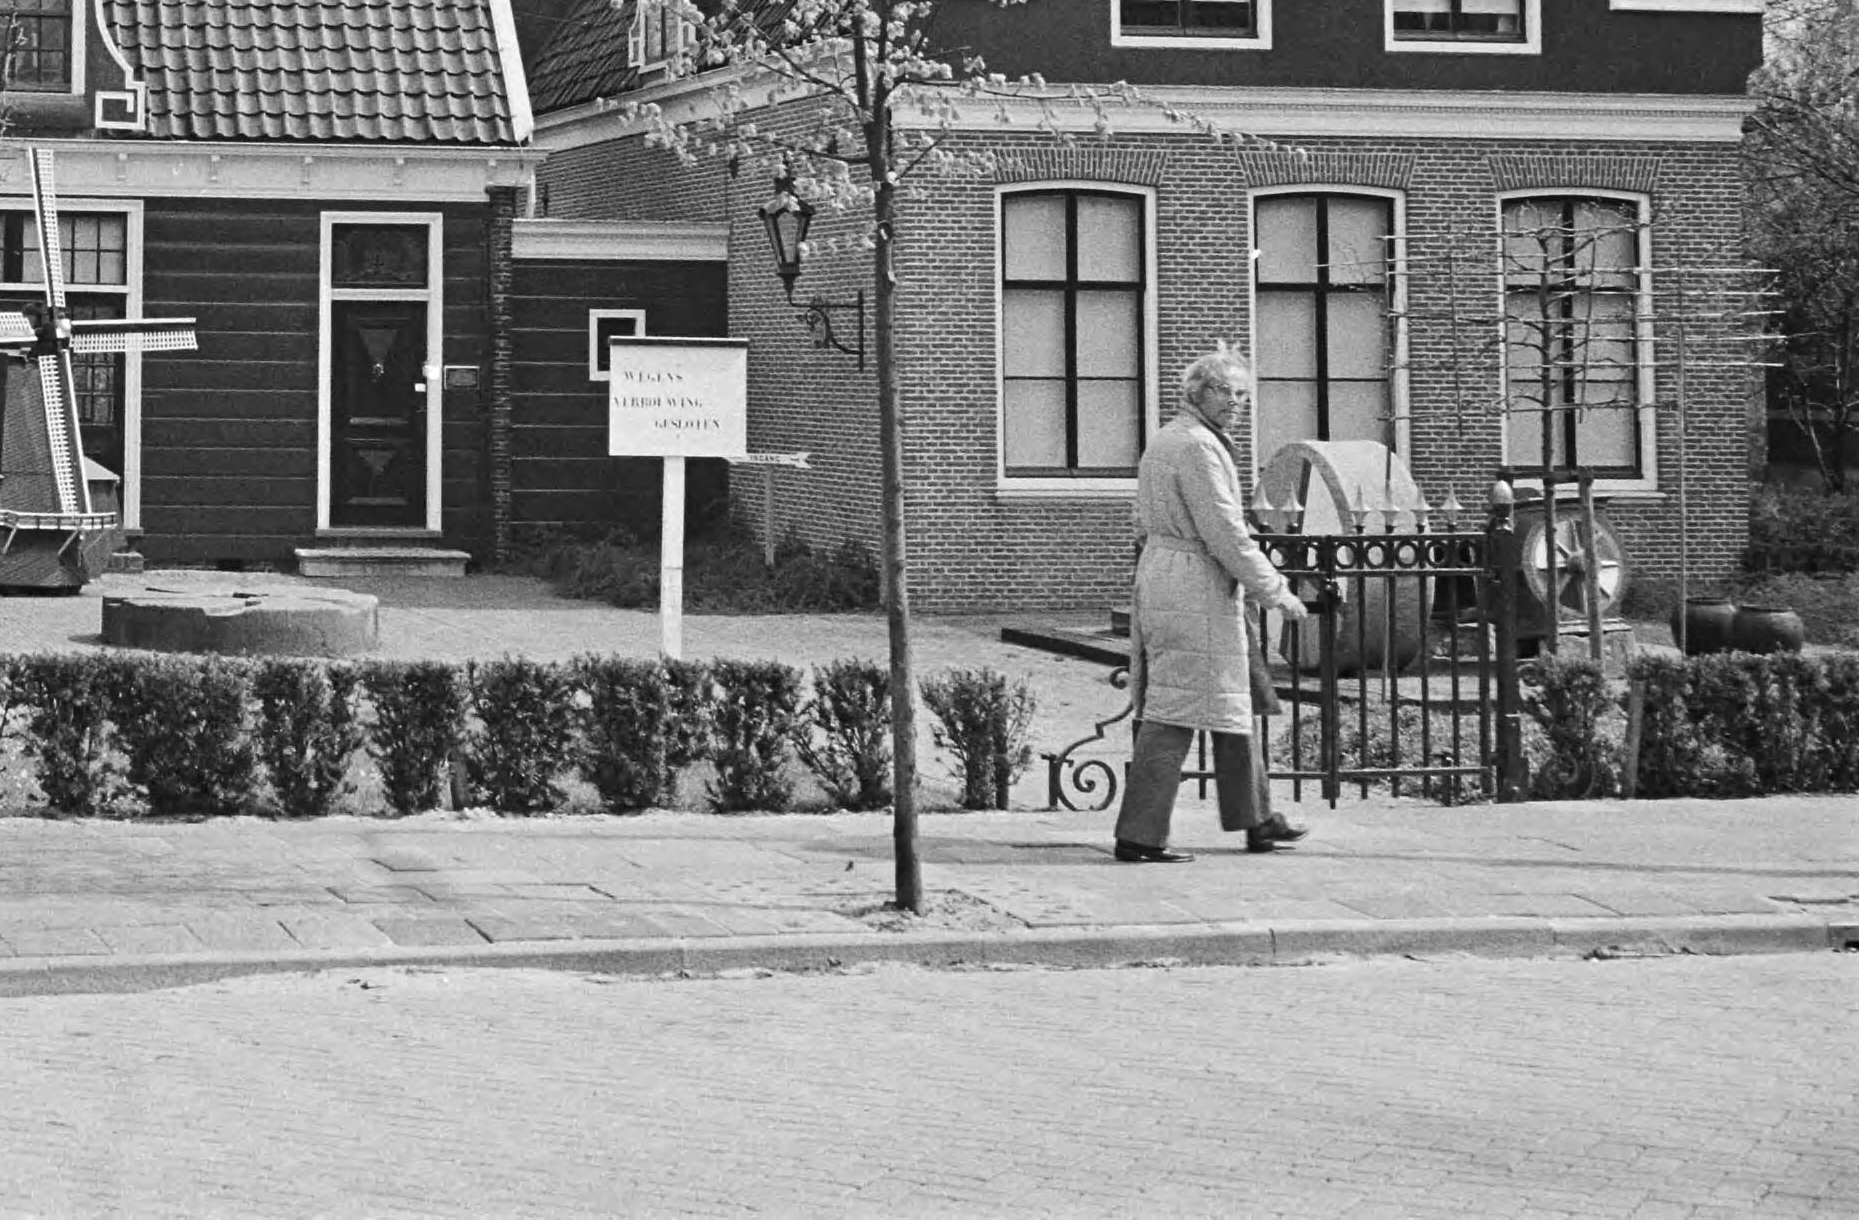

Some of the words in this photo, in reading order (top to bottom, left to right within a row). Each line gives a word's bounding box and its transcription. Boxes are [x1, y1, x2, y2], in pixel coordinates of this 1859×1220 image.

[624, 371, 683, 382] WEGENS
[614, 397, 702, 408] VERBOUWING
[654, 419, 720, 430] GESLOTEN
